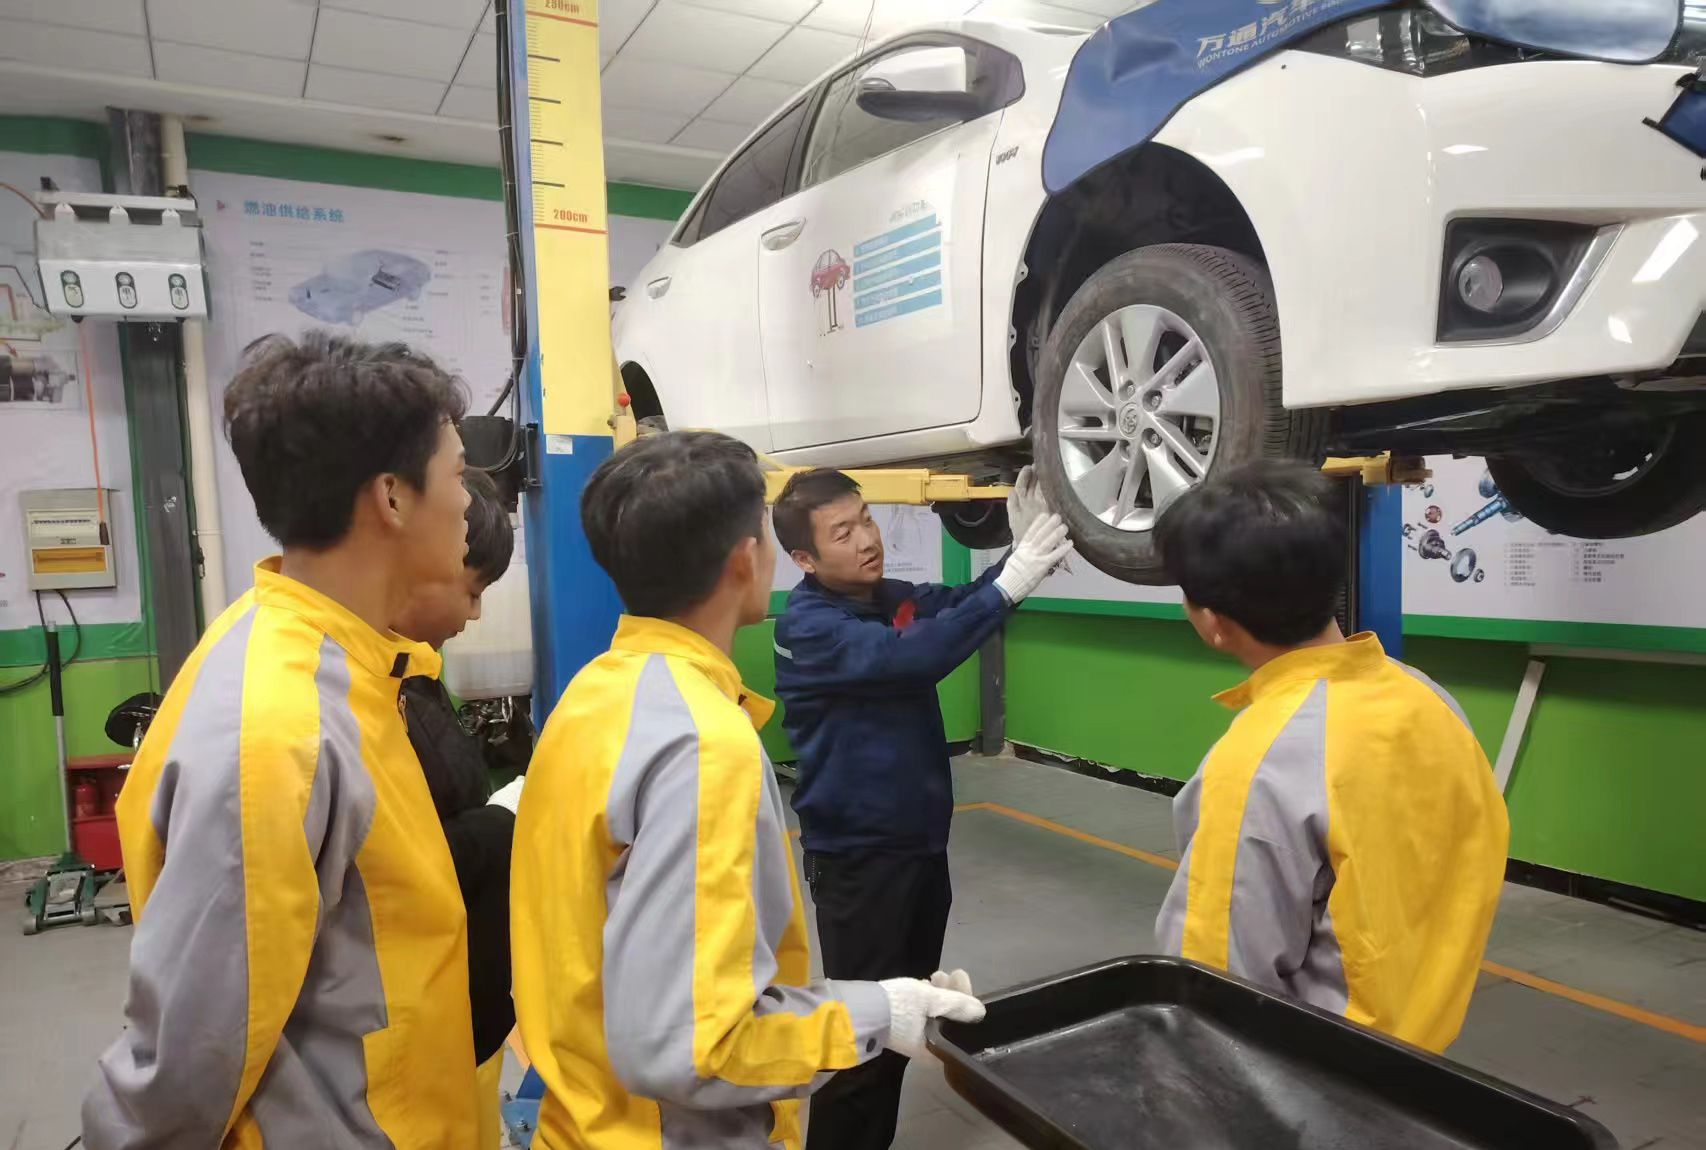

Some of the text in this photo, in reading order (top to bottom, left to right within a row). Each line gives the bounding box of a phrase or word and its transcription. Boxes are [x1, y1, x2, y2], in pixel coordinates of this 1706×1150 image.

[243, 200, 344, 223] 燃油供给系统
[553, 209, 588, 223] 200cm
